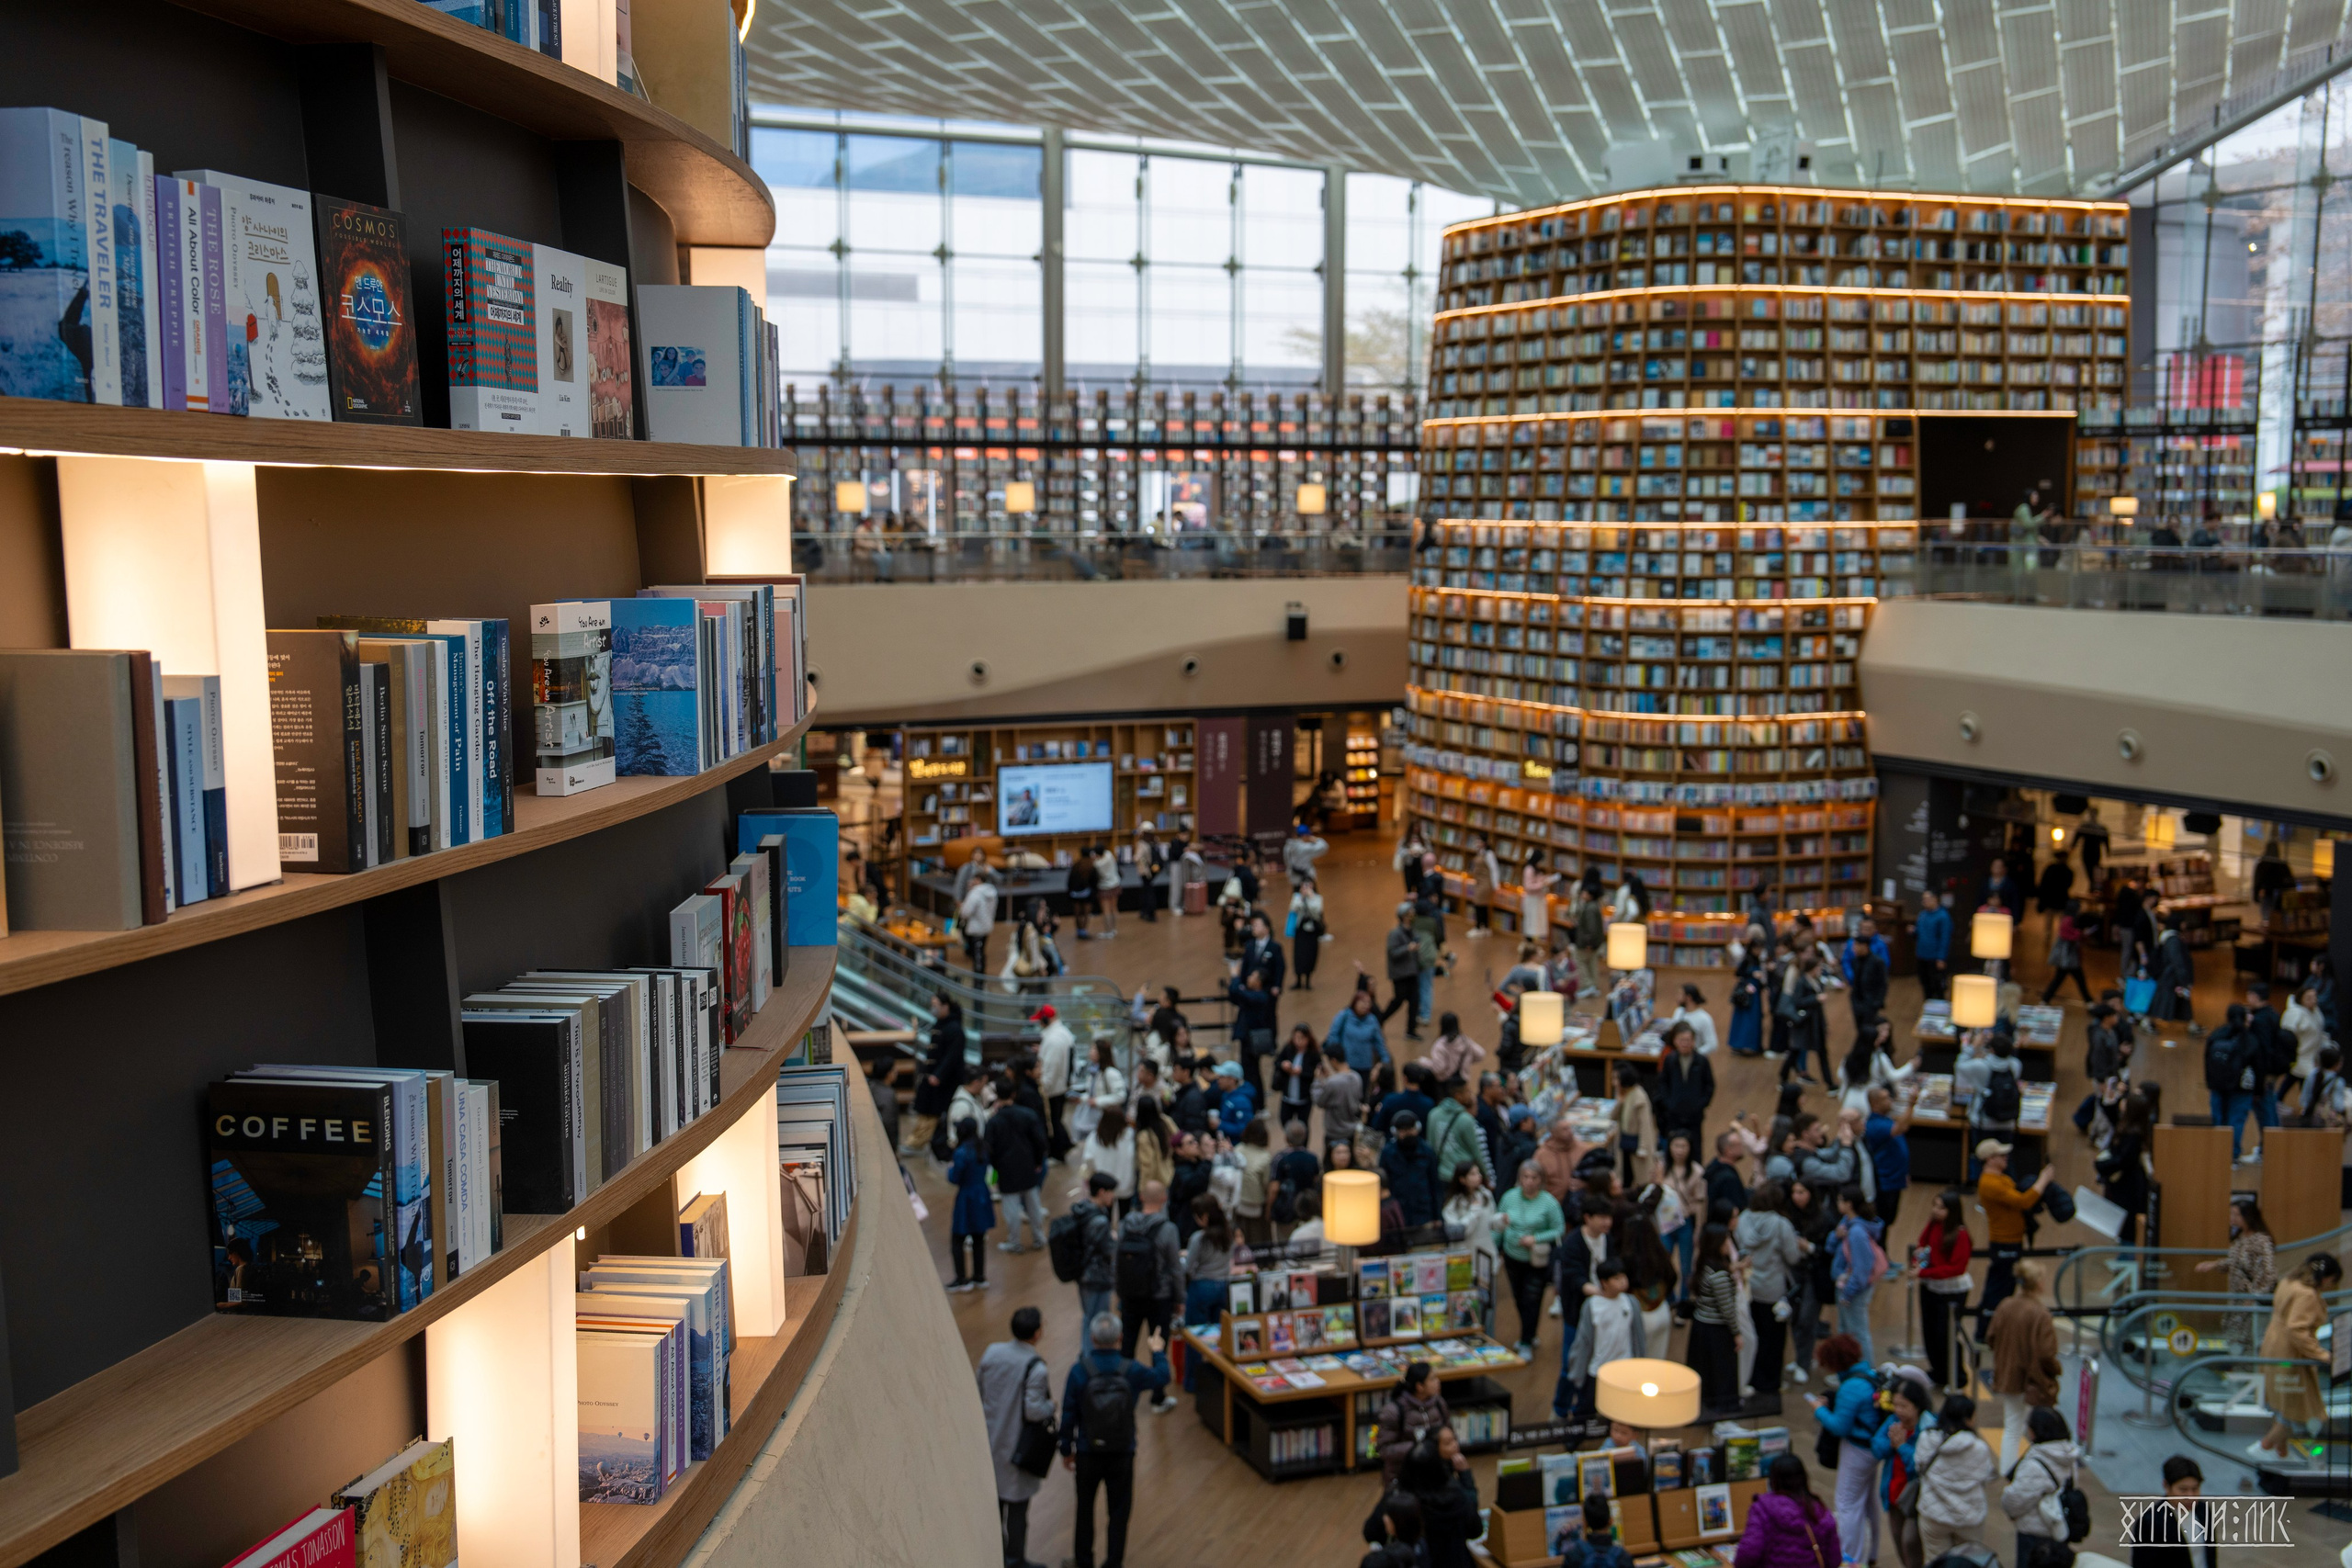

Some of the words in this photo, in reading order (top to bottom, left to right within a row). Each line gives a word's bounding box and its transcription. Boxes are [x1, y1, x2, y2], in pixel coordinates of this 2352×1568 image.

[63, 147, 74, 194] reason
[91, 138, 106, 184] THE
[66, 198, 79, 232] Why
[187, 207, 197, 226] All
[333, 213, 395, 239] COSMOS
[167, 201, 175, 269] BRITISH
[206, 208, 219, 253] THE
[253, 222, 288, 240] 사나이의
[334, 232, 367, 243] POSSIBLE
[370, 239, 396, 249] WORLDS
[93, 189, 111, 310] TRAVELER
[189, 229, 199, 272] About
[248, 241, 288, 260] 크리스마스
[355, 276, 362, 290] 앤
[364, 277, 383, 293] 드루얀
[452, 247, 464, 299] 어제까지의
[495, 274, 514, 289] UNTIL
[497, 261, 522, 278] WORLD
[595, 273, 617, 288] LARTIGUE
[191, 276, 200, 315] Color
[209, 258, 220, 315] ROSE
[486, 285, 523, 304] YESTERDAY
[551, 274, 573, 299] Reality
[170, 278, 179, 346] PREPPIE
[341, 294, 402, 326] 코스모스
[454, 299, 465, 321] 세계
[578, 616, 587, 628] You
[588, 615, 597, 627] Are
[583, 632, 606, 649] Artist
[543, 649, 552, 667] You
[544, 668, 552, 686] Are
[454, 722, 459, 733] of
[487, 709, 496, 736] the
[544, 705, 557, 749] Artist
[488, 740, 497, 779] Road
[458, 1091, 466, 1121] UNA
[215, 1114, 372, 1144] COFFEE
[383, 1095, 391, 1151] BLENDING
[408, 1103, 417, 1140] reason
[408, 1143, 418, 1170] Why
[458, 1123, 467, 1162] CASA
[459, 1164, 469, 1213] COMDA
[300, 1518, 346, 1568] JONASSON
